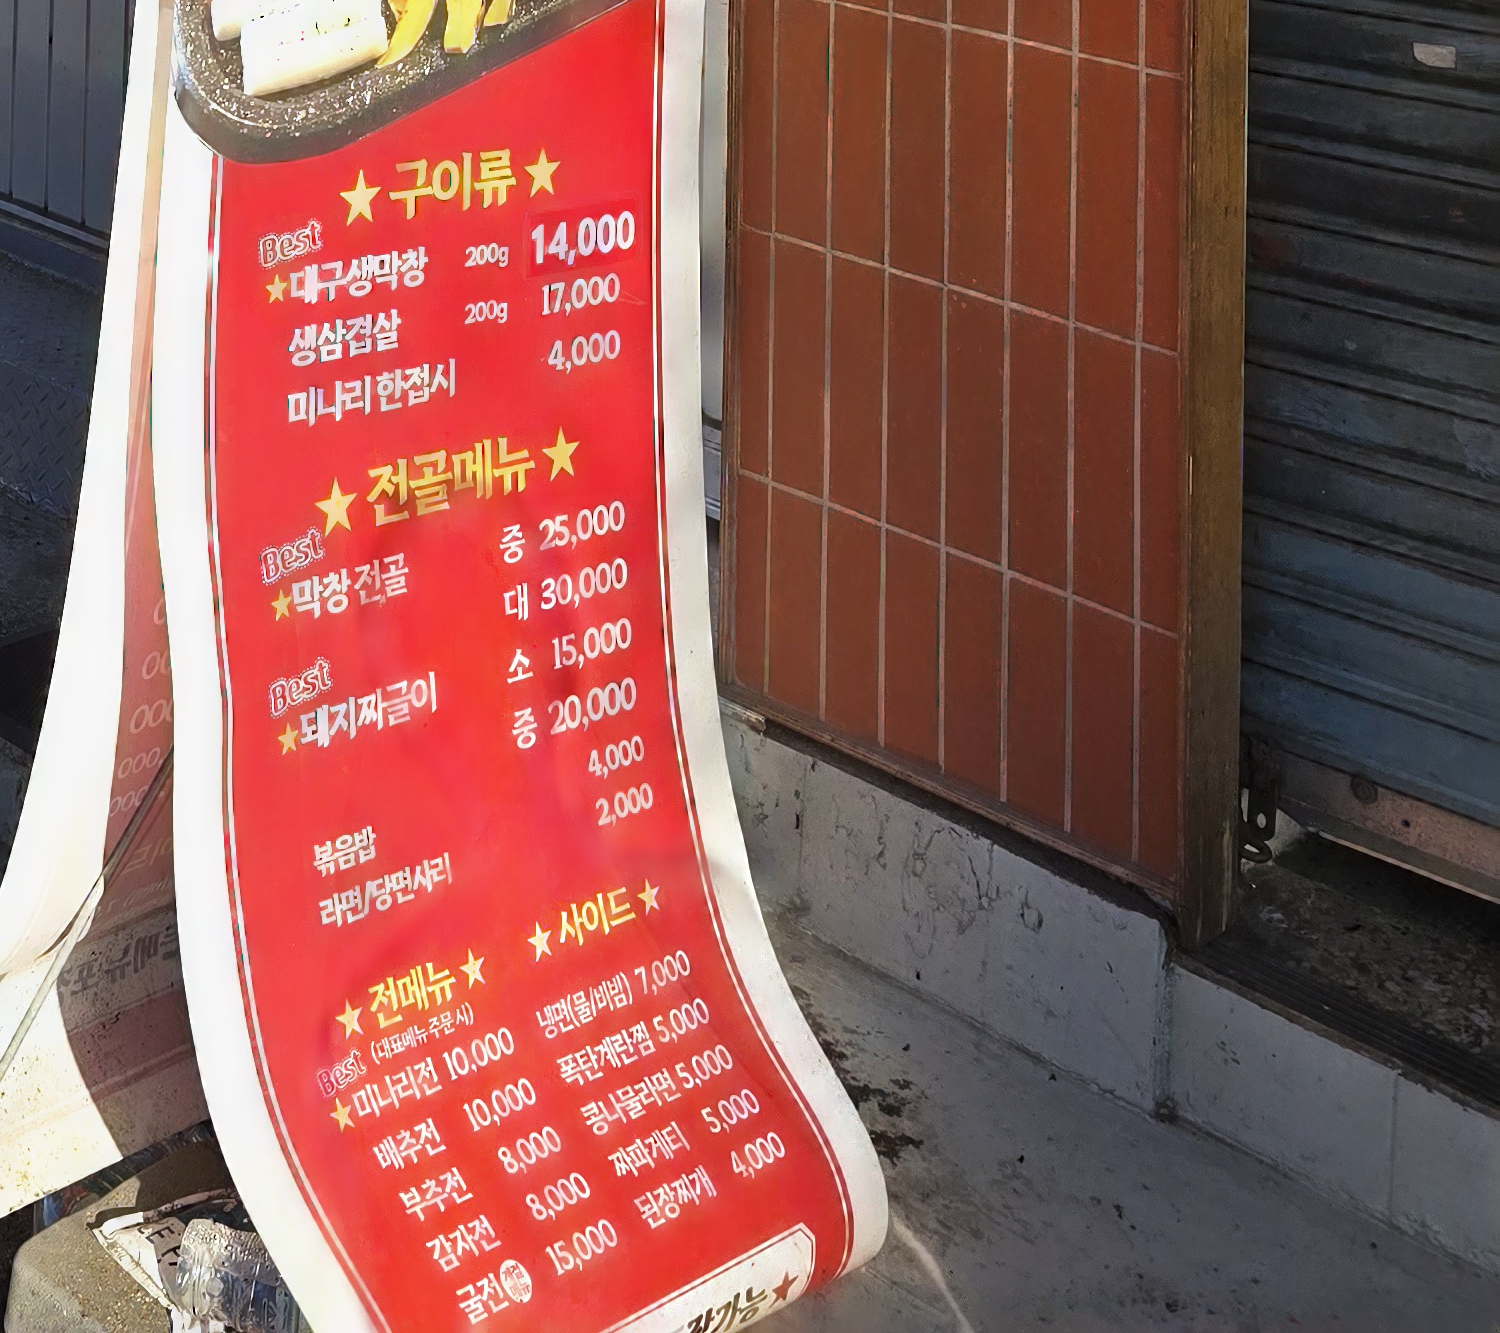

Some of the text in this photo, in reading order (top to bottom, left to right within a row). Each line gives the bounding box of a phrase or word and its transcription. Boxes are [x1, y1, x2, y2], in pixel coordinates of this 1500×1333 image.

[388, 148, 517, 220] 구이류
[259, 219, 322, 268] Best
[289, 210, 636, 304] 대구생막창 200g 14,000
[288, 272, 621, 367] 생삼겹살 200g 17,000
[547, 329, 621, 375] 4,000
[367, 436, 536, 527] 전골메뉴
[260, 527, 326, 585] Best
[500, 523, 526, 564] 중
[538, 499, 626, 552] 25,000
[503, 557, 628, 621] 대 30,000
[269, 656, 334, 718] Best
[299, 617, 633, 748] 돼지짜글이 소 15,000
[511, 676, 637, 750] 중 20,000
[312, 735, 645, 878] 볶음밥 4,000
[318, 782, 654, 928] 라면/당면사리 2,000
[558, 886, 637, 947] 사이드
[367, 962, 457, 1029] 전메뉴
[535, 949, 691, 1040] 냉면(물/비빔) 7,000
[316, 1047, 368, 1098] Best
[351, 1027, 515, 1118] 미나리전 10,000
[555, 997, 711, 1086] 폭탄계란찜 5,000
[372, 1078, 536, 1174] 배추전 10,000
[579, 1043, 733, 1138] 콩나물라면 5,000
[607, 1088, 761, 1180] 짜파게티 5,000
[398, 1125, 562, 1223] 부추전 8,000
[633, 1131, 787, 1230] 된장찌개 4,000
[425, 1171, 592, 1274] 감자전 8,000
[455, 1218, 619, 1325] 굴전 15,000
